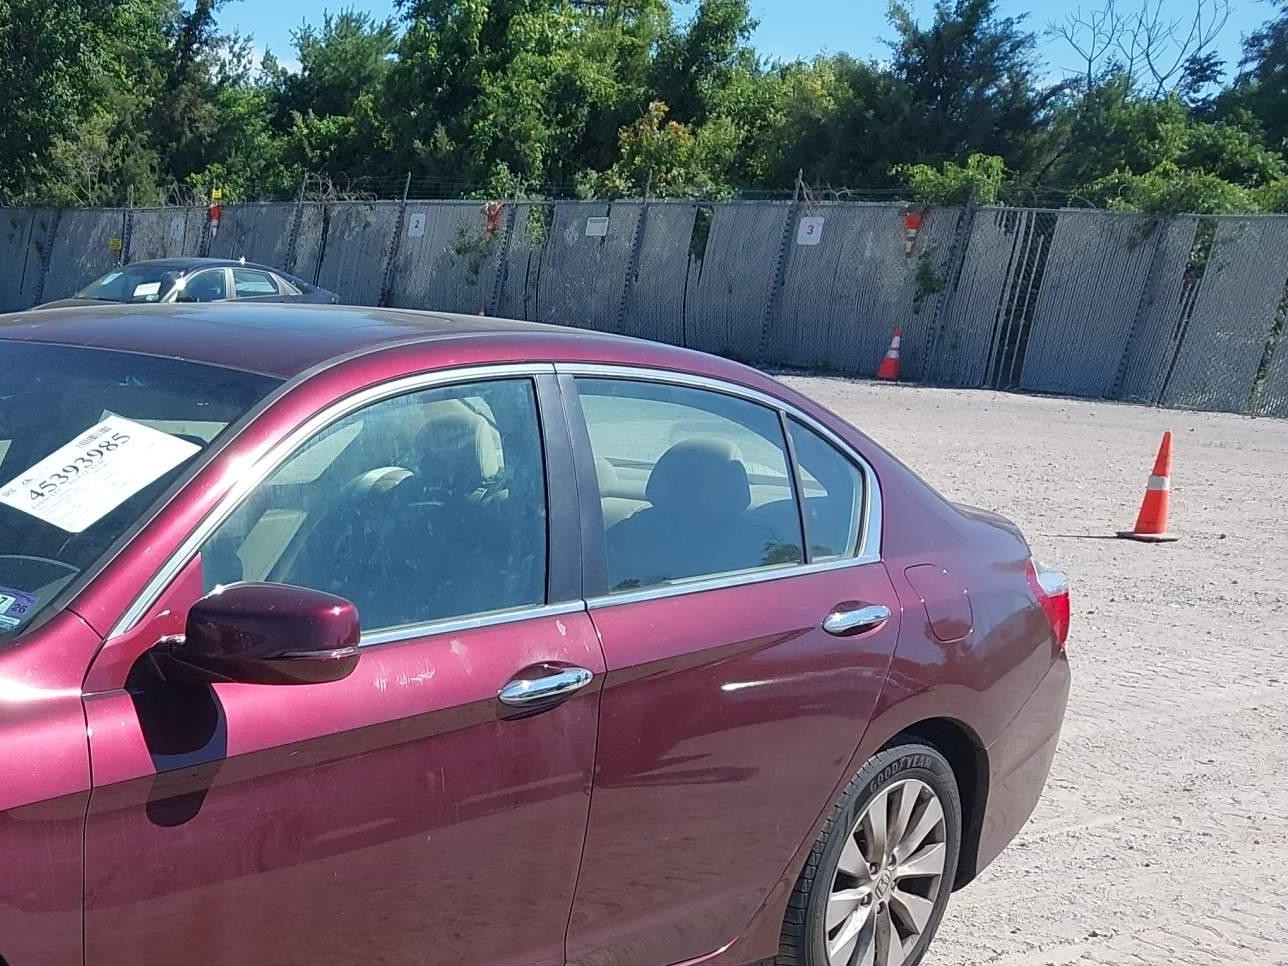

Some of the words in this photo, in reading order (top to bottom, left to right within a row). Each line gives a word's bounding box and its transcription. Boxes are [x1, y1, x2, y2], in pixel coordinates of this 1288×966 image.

[806, 224, 815, 236] 3
[29, 432, 131, 501] 45393985
[11, 603, 28, 614] 26
